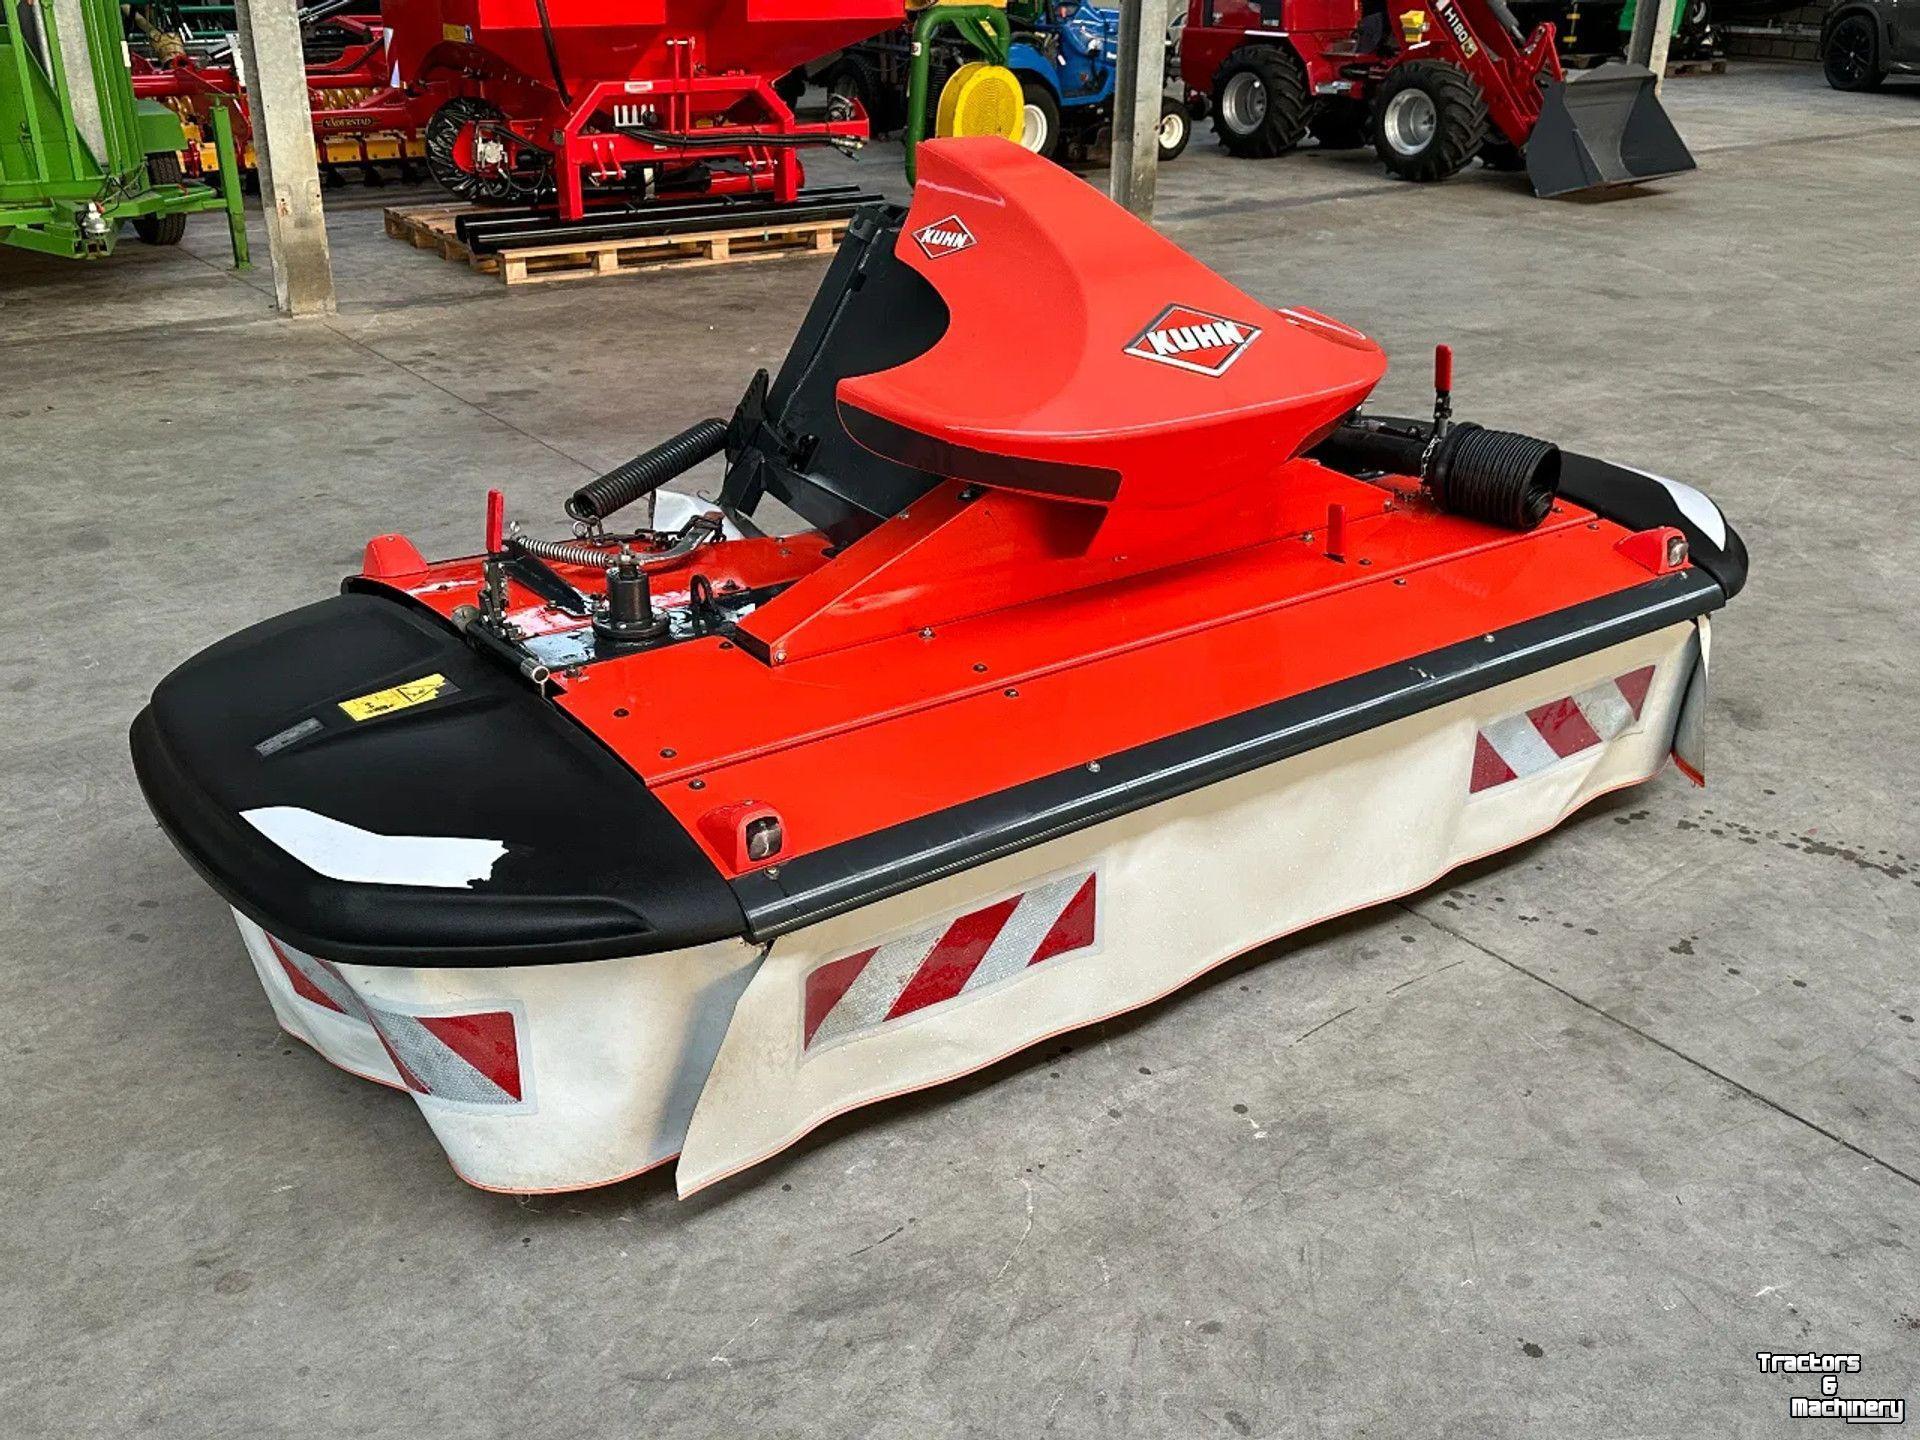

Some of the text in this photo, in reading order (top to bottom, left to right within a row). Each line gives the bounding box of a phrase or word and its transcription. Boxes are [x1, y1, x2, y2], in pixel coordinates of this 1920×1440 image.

[1444, 6, 1469, 42] H180
[920, 229, 968, 248] KUHN
[1145, 320, 1245, 356] KUHN
